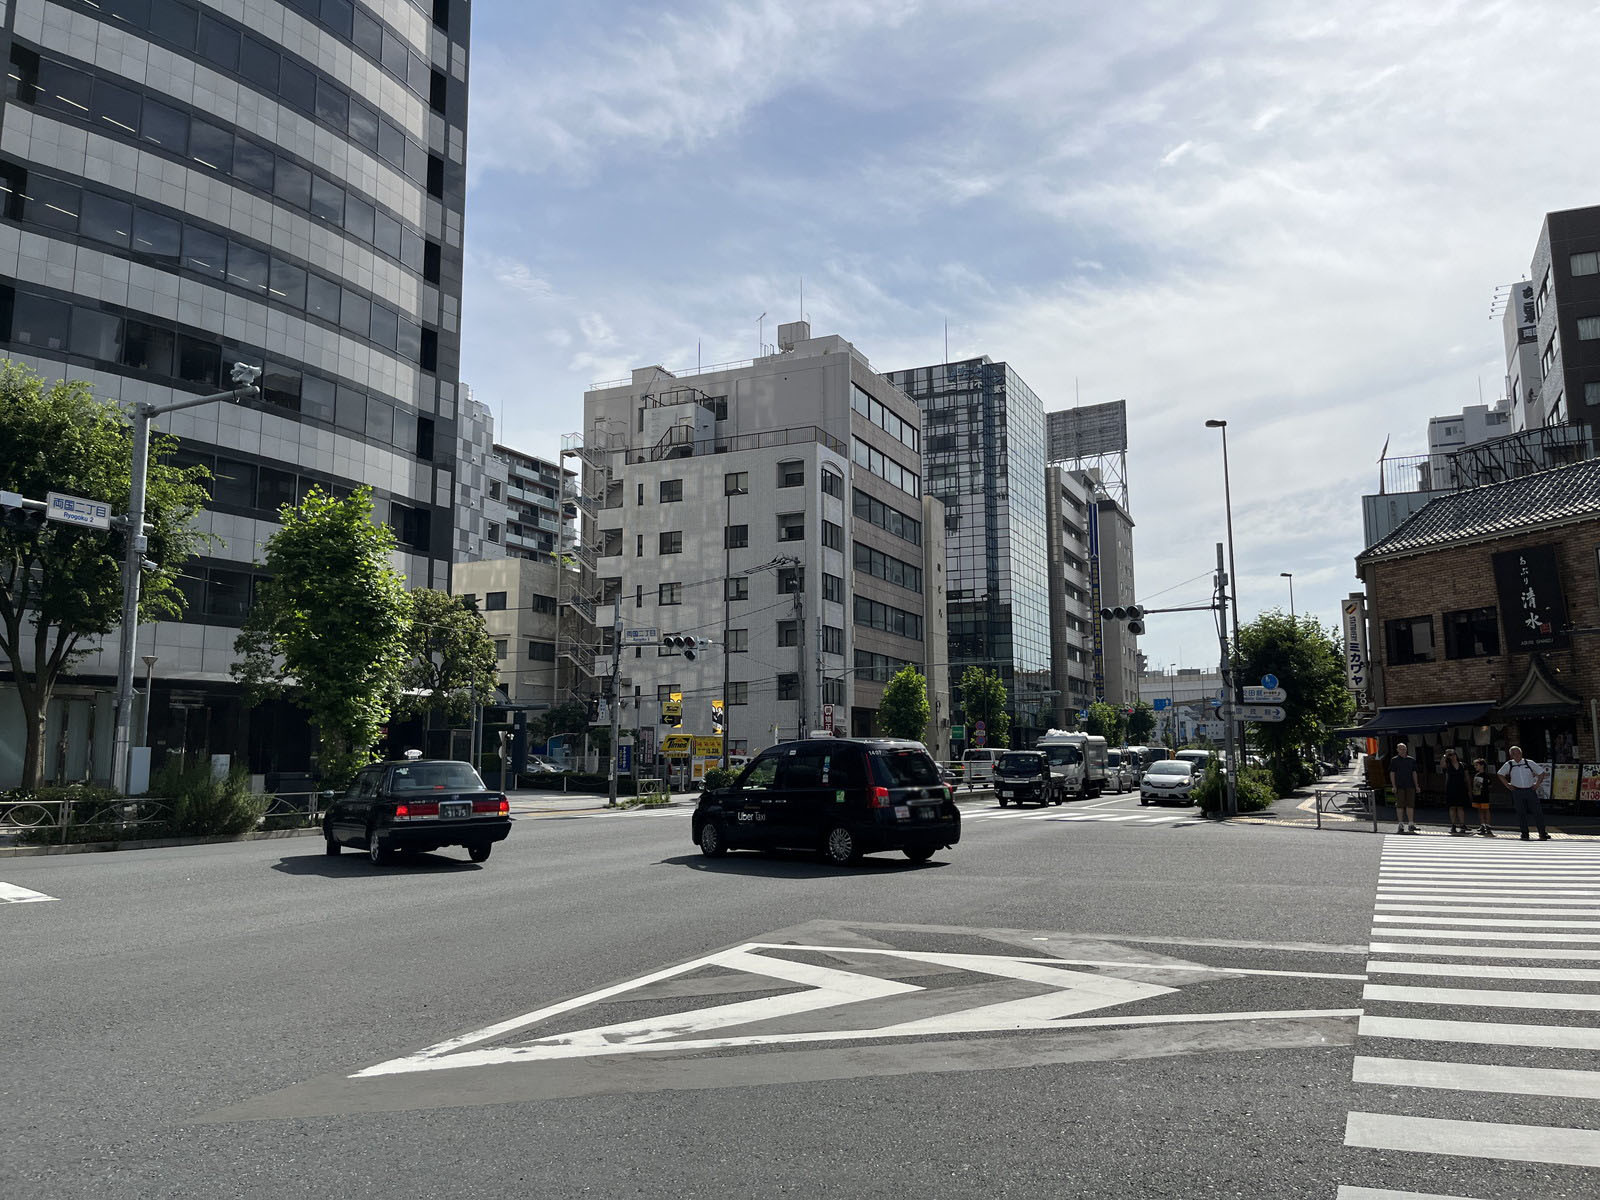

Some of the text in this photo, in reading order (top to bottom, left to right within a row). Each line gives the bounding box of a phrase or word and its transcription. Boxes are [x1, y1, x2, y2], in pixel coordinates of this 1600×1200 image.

[53, 498, 106, 517] 両国二丁目
[64, 512, 88, 522] Ryogoku
[1521, 587, 1543, 630] 清水
[666, 737, 690, 749] Times
[737, 811, 766, 821] Uber Taxi
